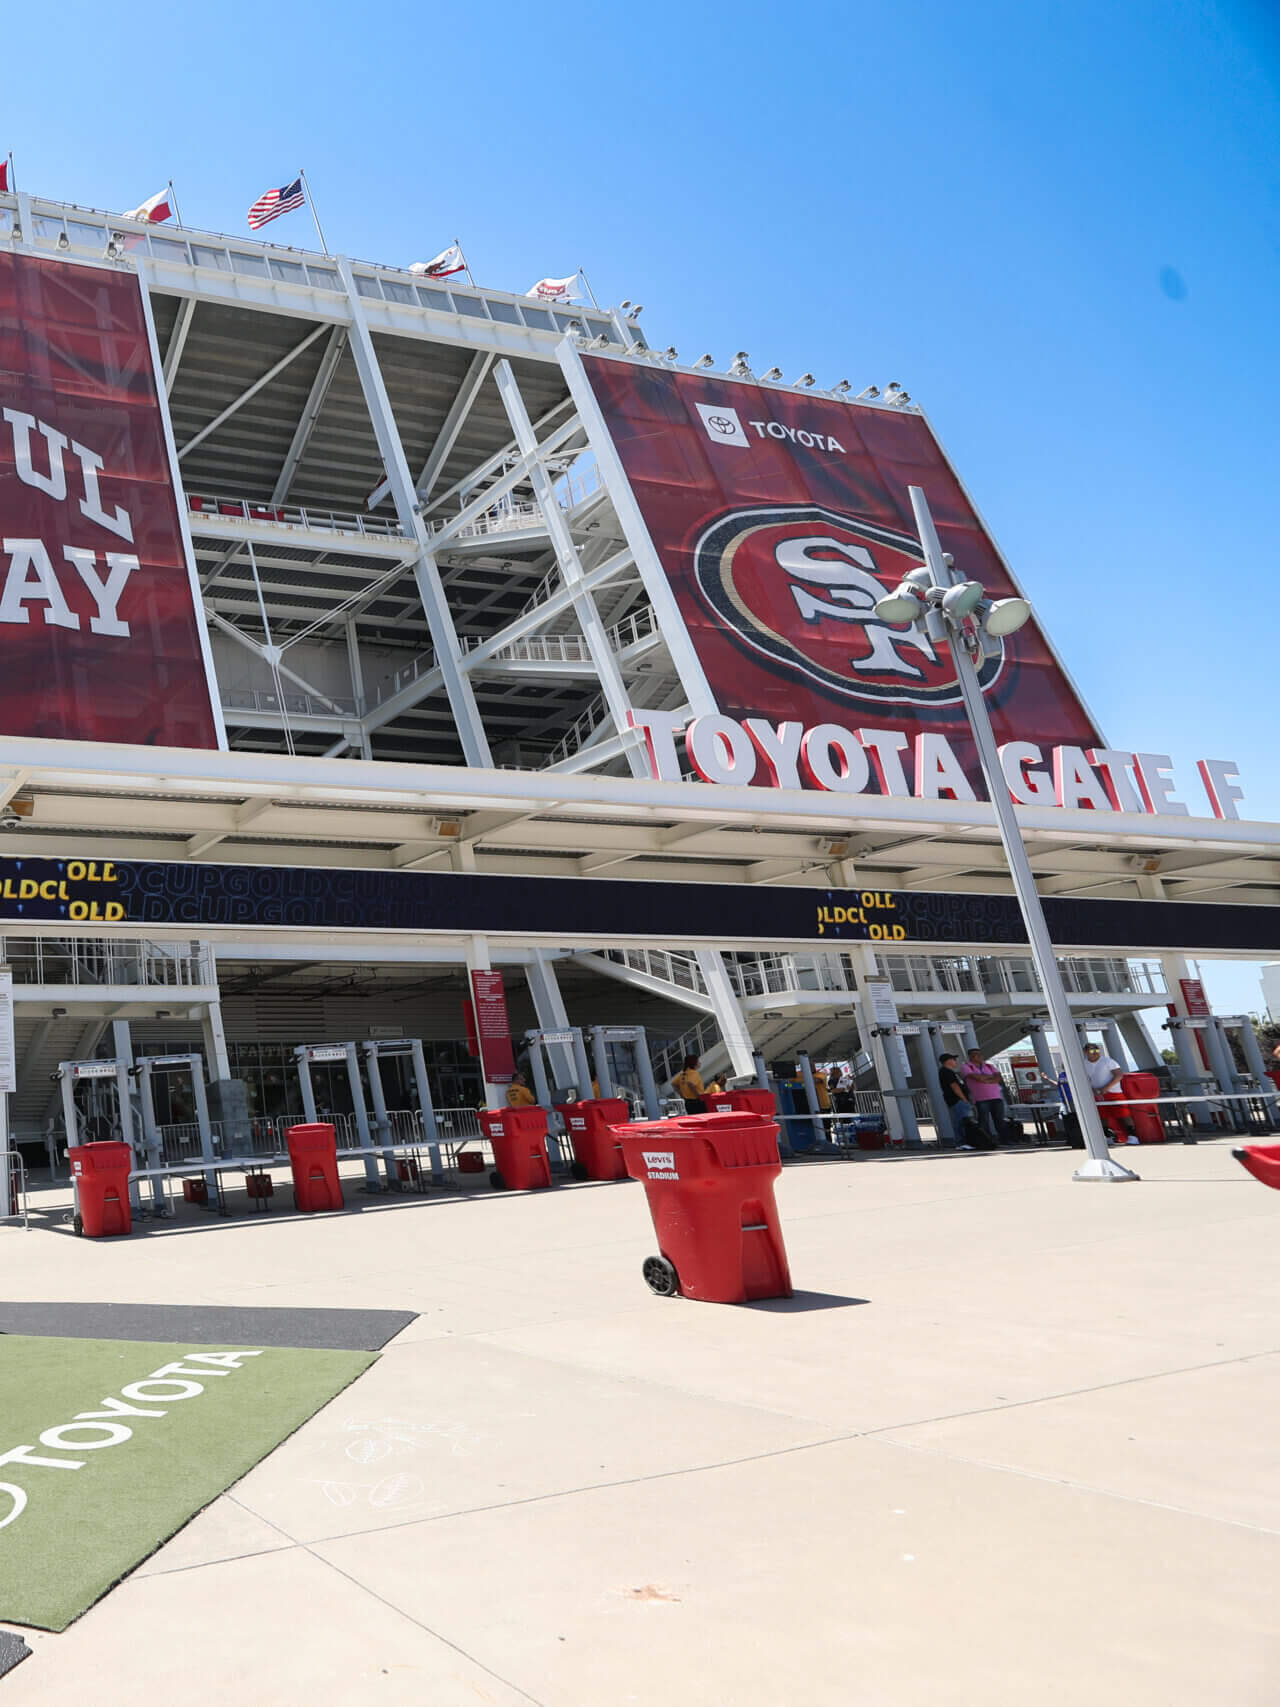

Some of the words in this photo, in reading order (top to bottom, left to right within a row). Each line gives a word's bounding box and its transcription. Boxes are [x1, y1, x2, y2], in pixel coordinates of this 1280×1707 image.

[749, 420, 847, 454] TOYOTA
[626, 707, 977, 801] TOYOTA
[997, 740, 1189, 815] GATE
[1196, 758, 1245, 820] F
